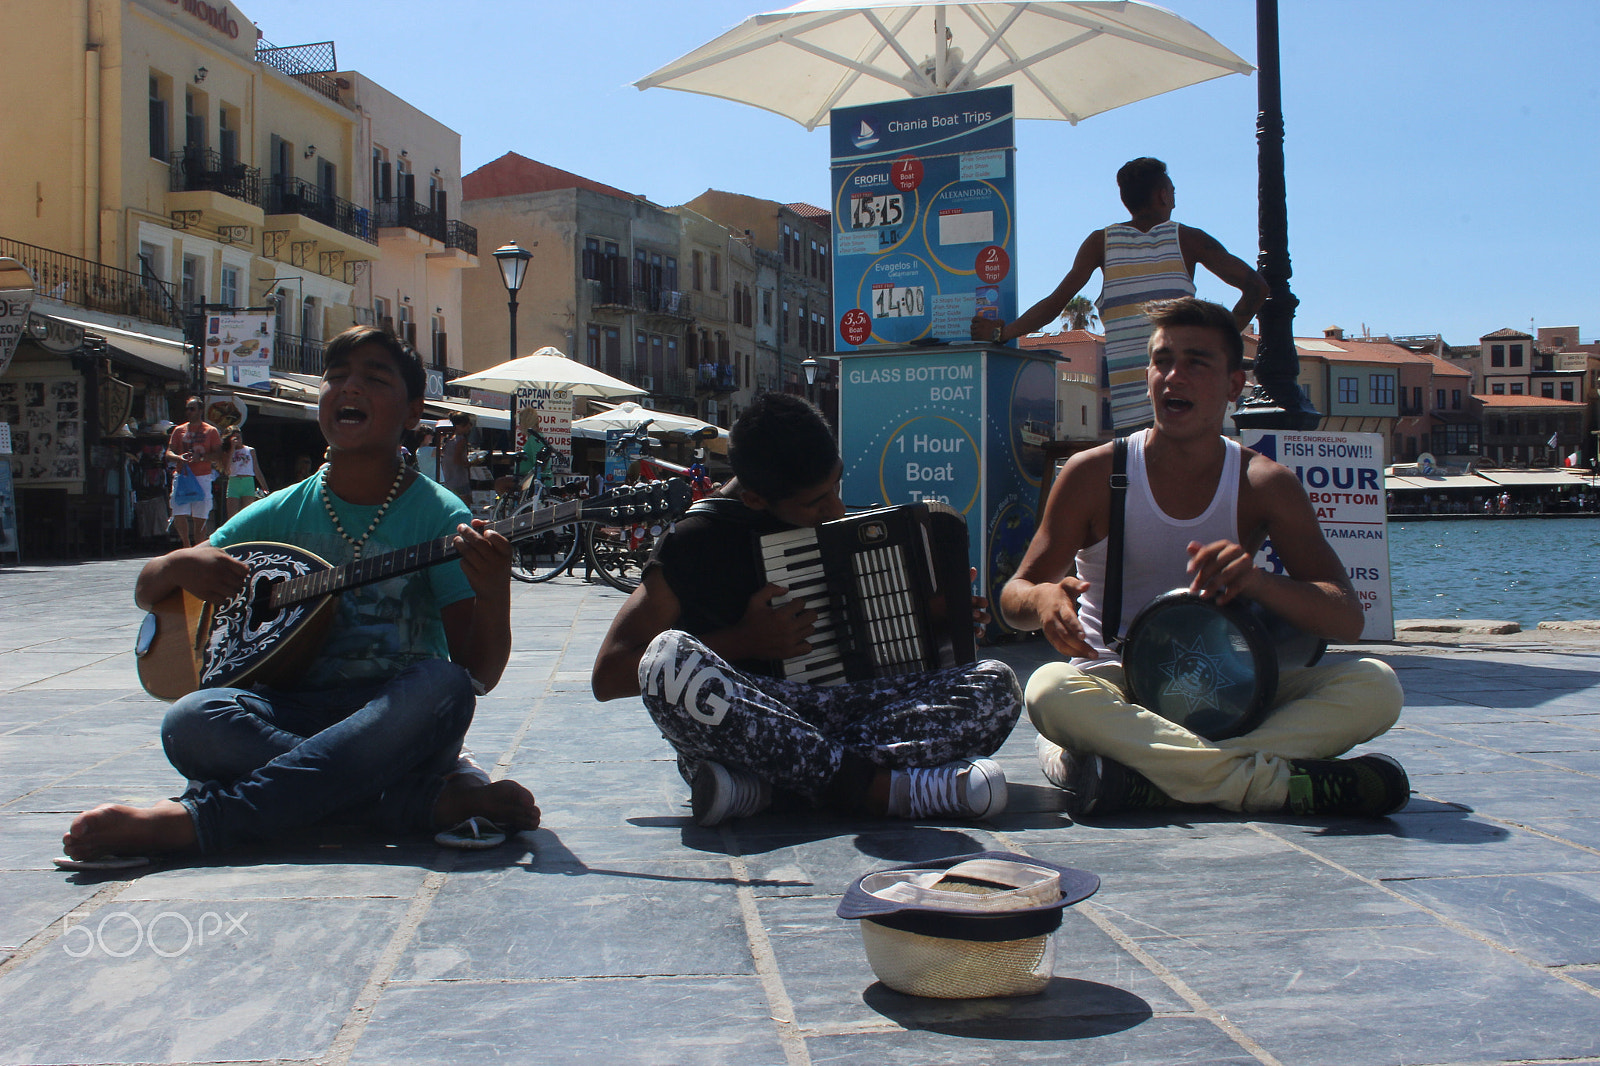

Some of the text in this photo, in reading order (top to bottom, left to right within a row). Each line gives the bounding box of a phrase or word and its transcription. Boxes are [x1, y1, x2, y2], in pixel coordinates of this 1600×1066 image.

[888, 111, 992, 133] Chania Boat Trips
[854, 173, 889, 185] EROFILI
[940, 187, 992, 200] ALEXANDROS
[853, 196, 902, 229] 15:15
[875, 262, 911, 273] Evagelos
[876, 288, 924, 318] 14:00
[849, 365, 973, 384] GLASS BOTTOM
[517, 388, 551, 399] CAPTAIN
[930, 386, 973, 401] BOAT
[519, 399, 545, 410] NICK
[895, 434, 964, 453] 1 Hour
[1284, 443, 1372, 459] FISH SHOW!!!
[906, 462, 954, 481] Boat
[1309, 492, 1378, 505] BOTTOM
[1316, 507, 1336, 518] AT
[1324, 528, 1383, 540] TAMARAN
[1347, 567, 1380, 580] URS
